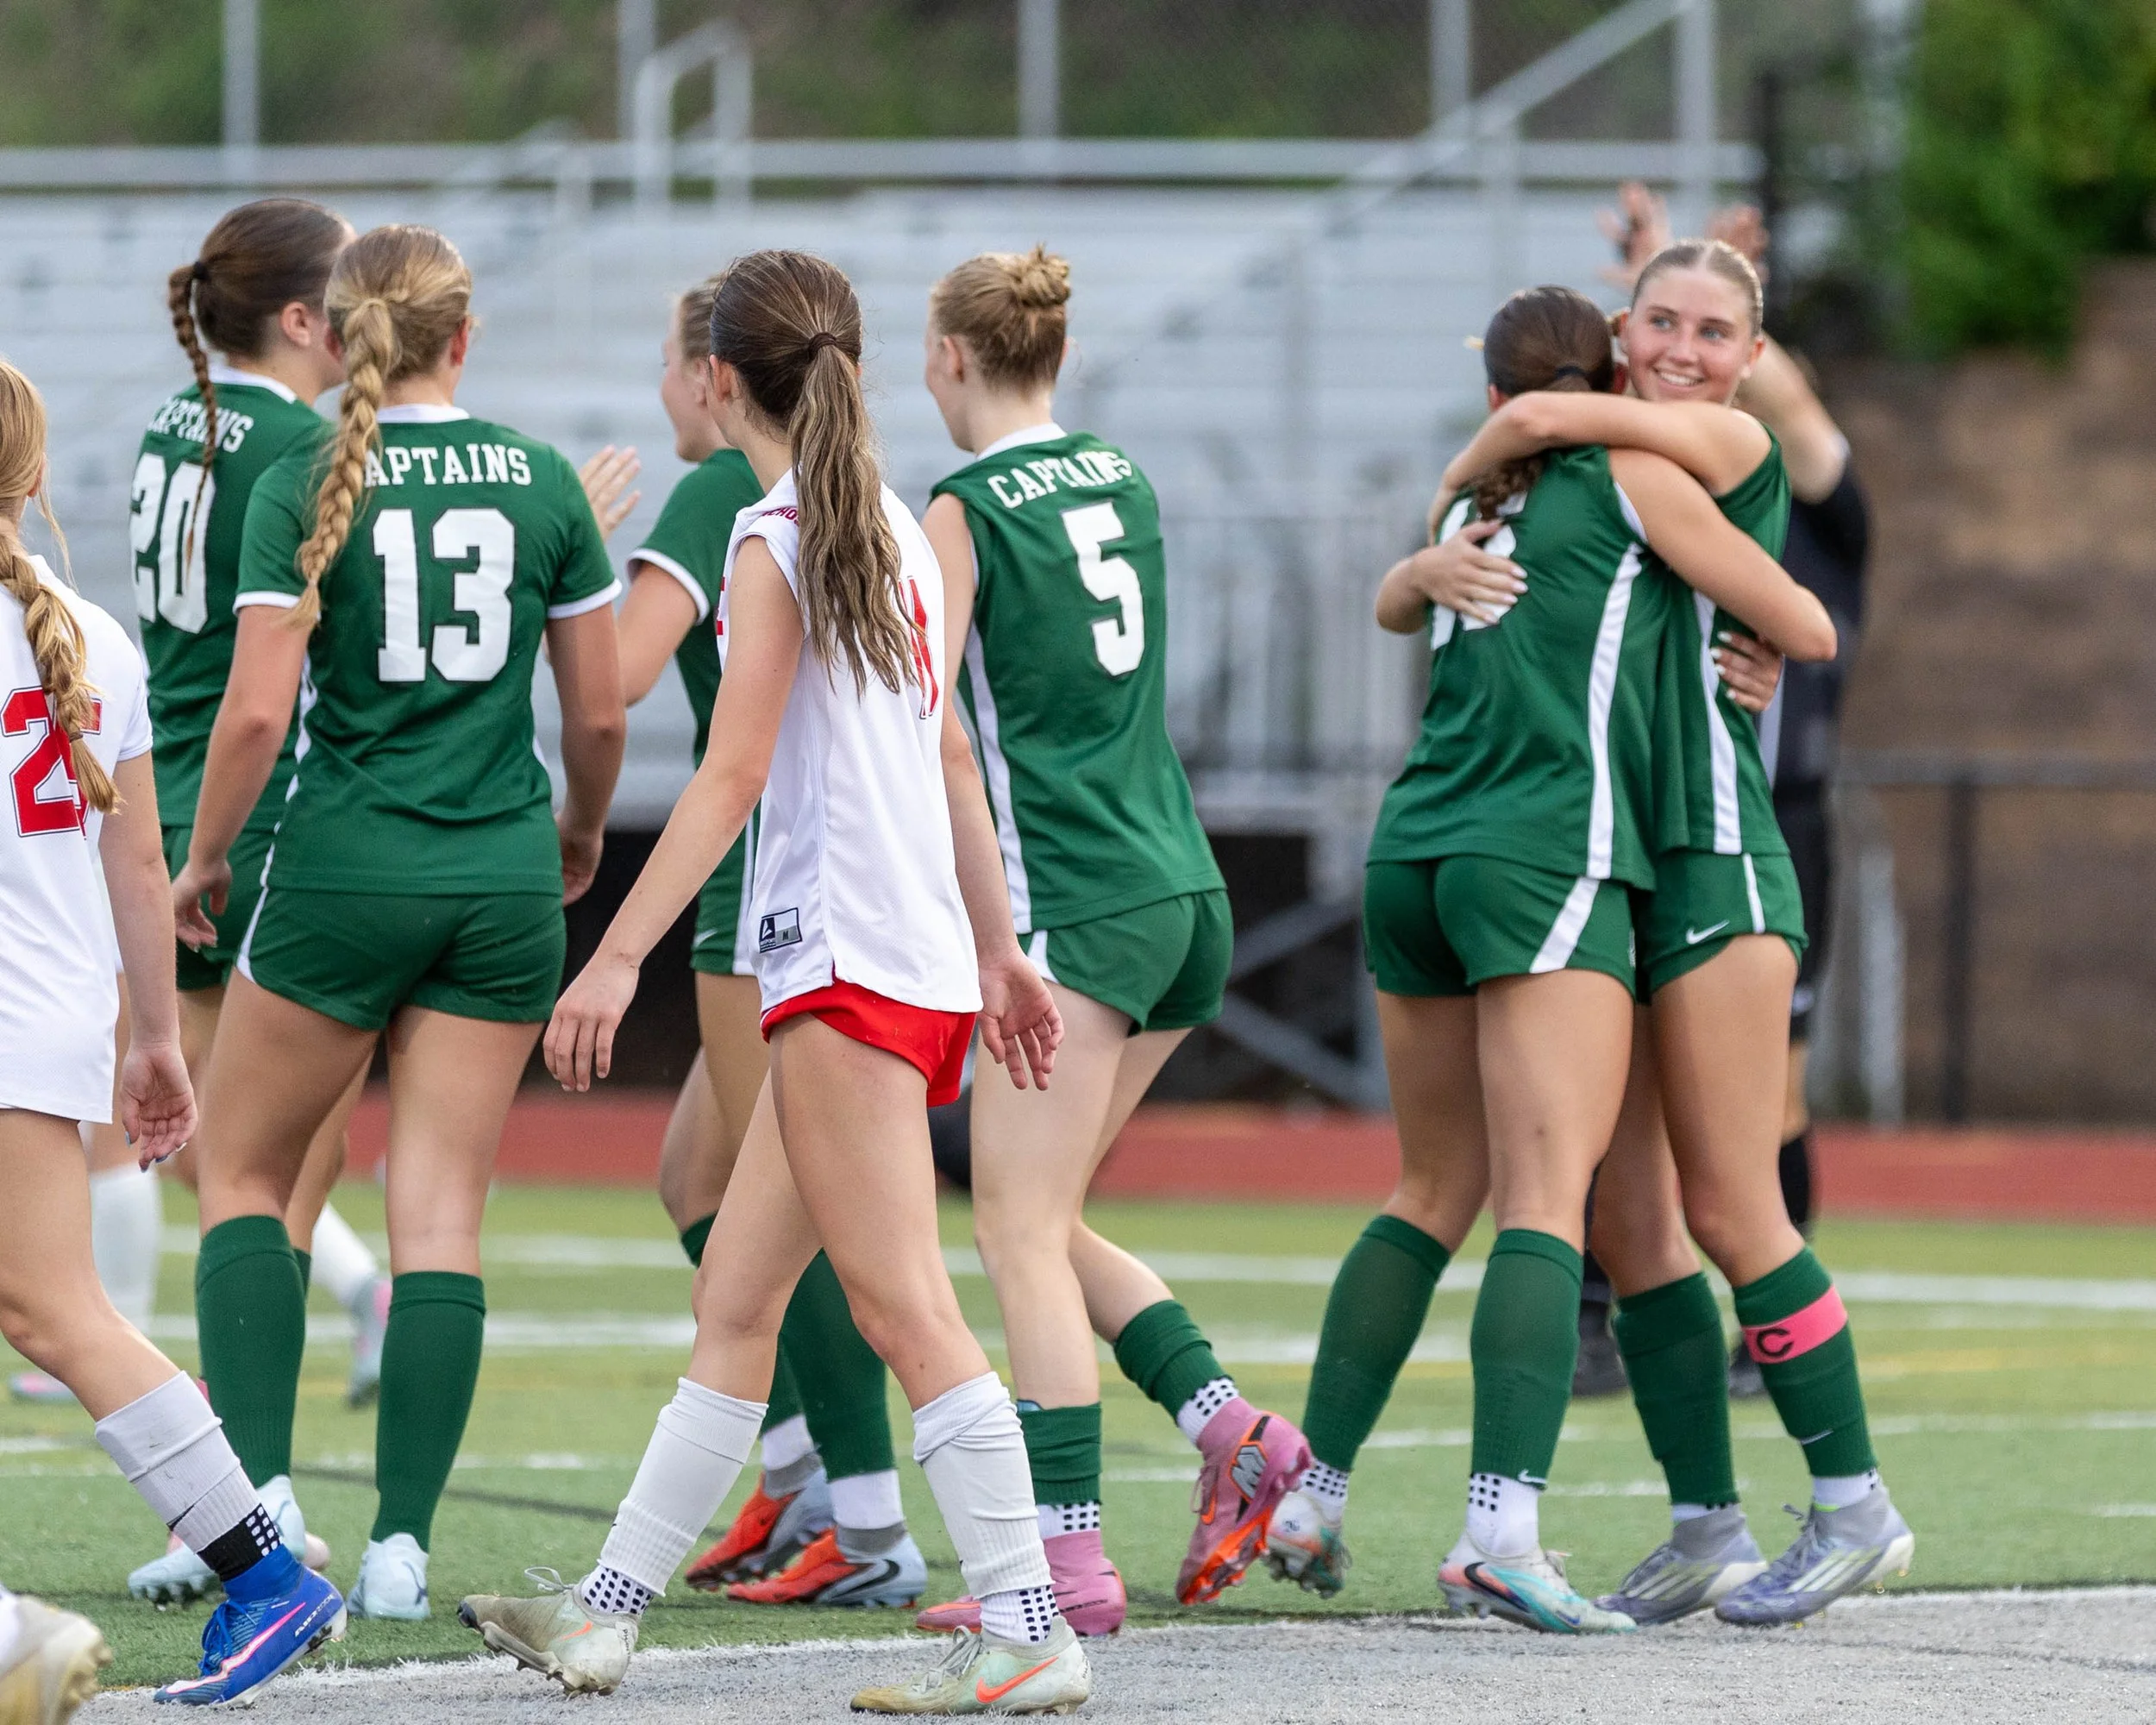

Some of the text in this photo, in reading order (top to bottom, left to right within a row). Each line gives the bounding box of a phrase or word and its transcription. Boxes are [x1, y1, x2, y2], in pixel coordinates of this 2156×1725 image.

[147, 397, 255, 454] APTANS
[364, 443, 533, 488] APTAINS
[987, 450, 1133, 510] CAPTAINS
[129, 451, 216, 635] 20
[372, 507, 515, 682] 13
[1061, 499, 1145, 678] 5
[0, 686, 103, 839] 2
[1756, 1327, 1795, 1358] C
